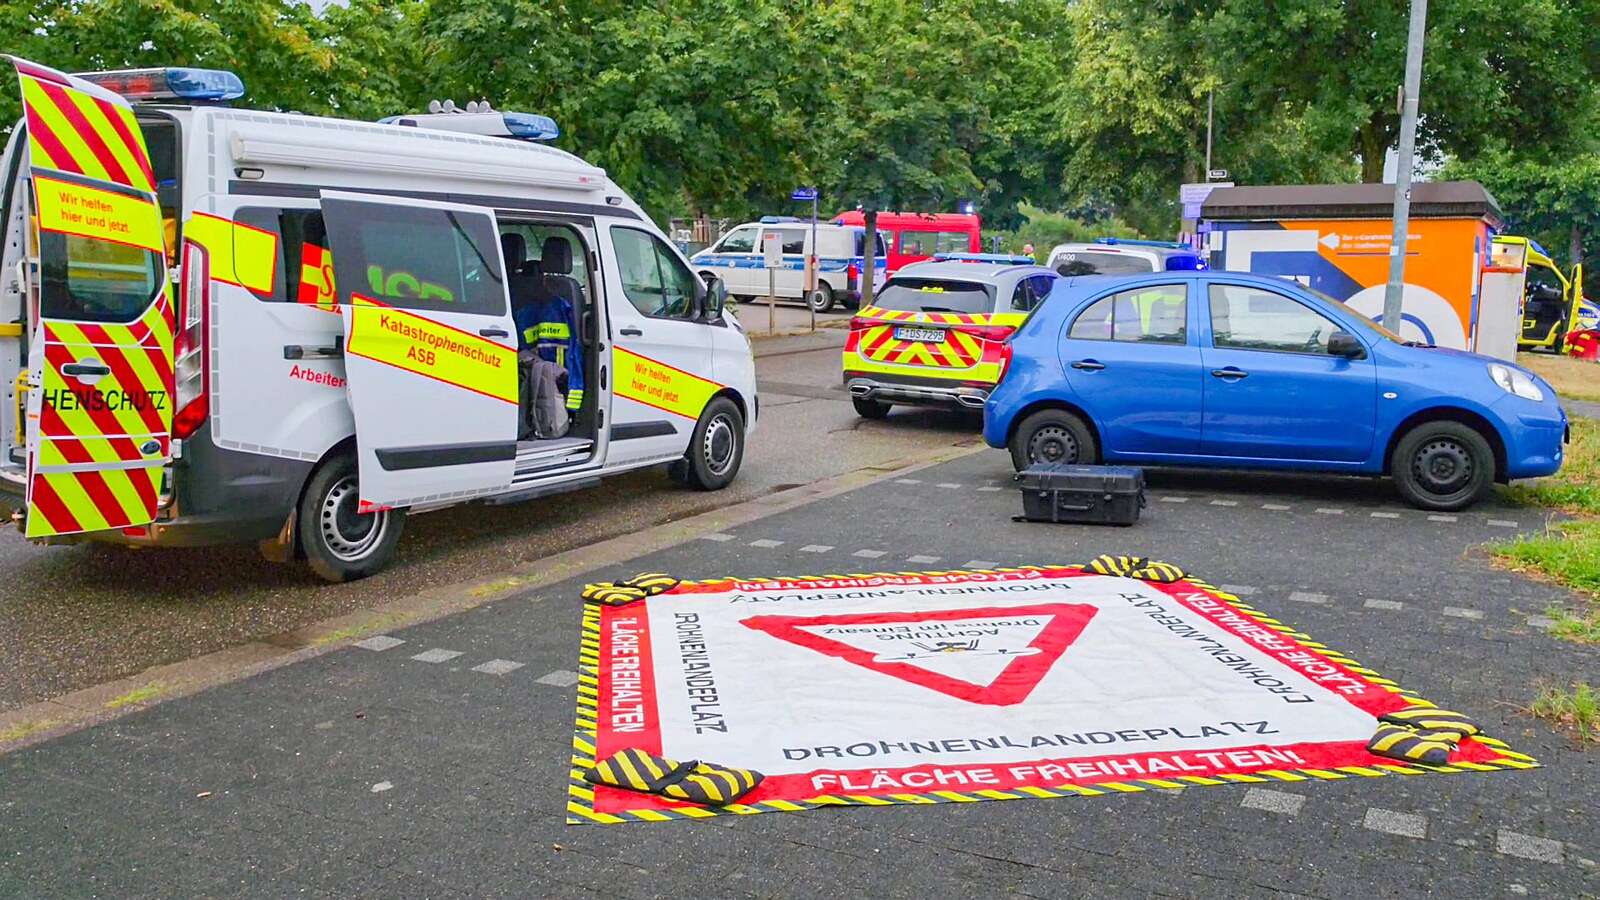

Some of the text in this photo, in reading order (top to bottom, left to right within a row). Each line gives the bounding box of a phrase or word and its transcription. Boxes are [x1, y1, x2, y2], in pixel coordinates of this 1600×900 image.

[58, 191, 114, 213] Wir helfen
[60, 208, 83, 224] hier
[86, 213, 106, 229] und
[380, 314, 502, 368] Katastrophenschutz
[406, 345, 436, 366] ASB
[289, 364, 347, 389] Arbeiter-
[634, 361, 671, 385] Wir helfen
[42, 388, 166, 411] HENSCHUTZ
[631, 379, 647, 392] hier
[648, 384, 662, 398] und
[822, 626, 911, 635] Einsatz
[875, 628, 999, 641] ACHTUNG
[782, 718, 1280, 761] DROHNENLANDEPLATZ
[811, 748, 1305, 791] FLÄCHE FREIHALTEN!
